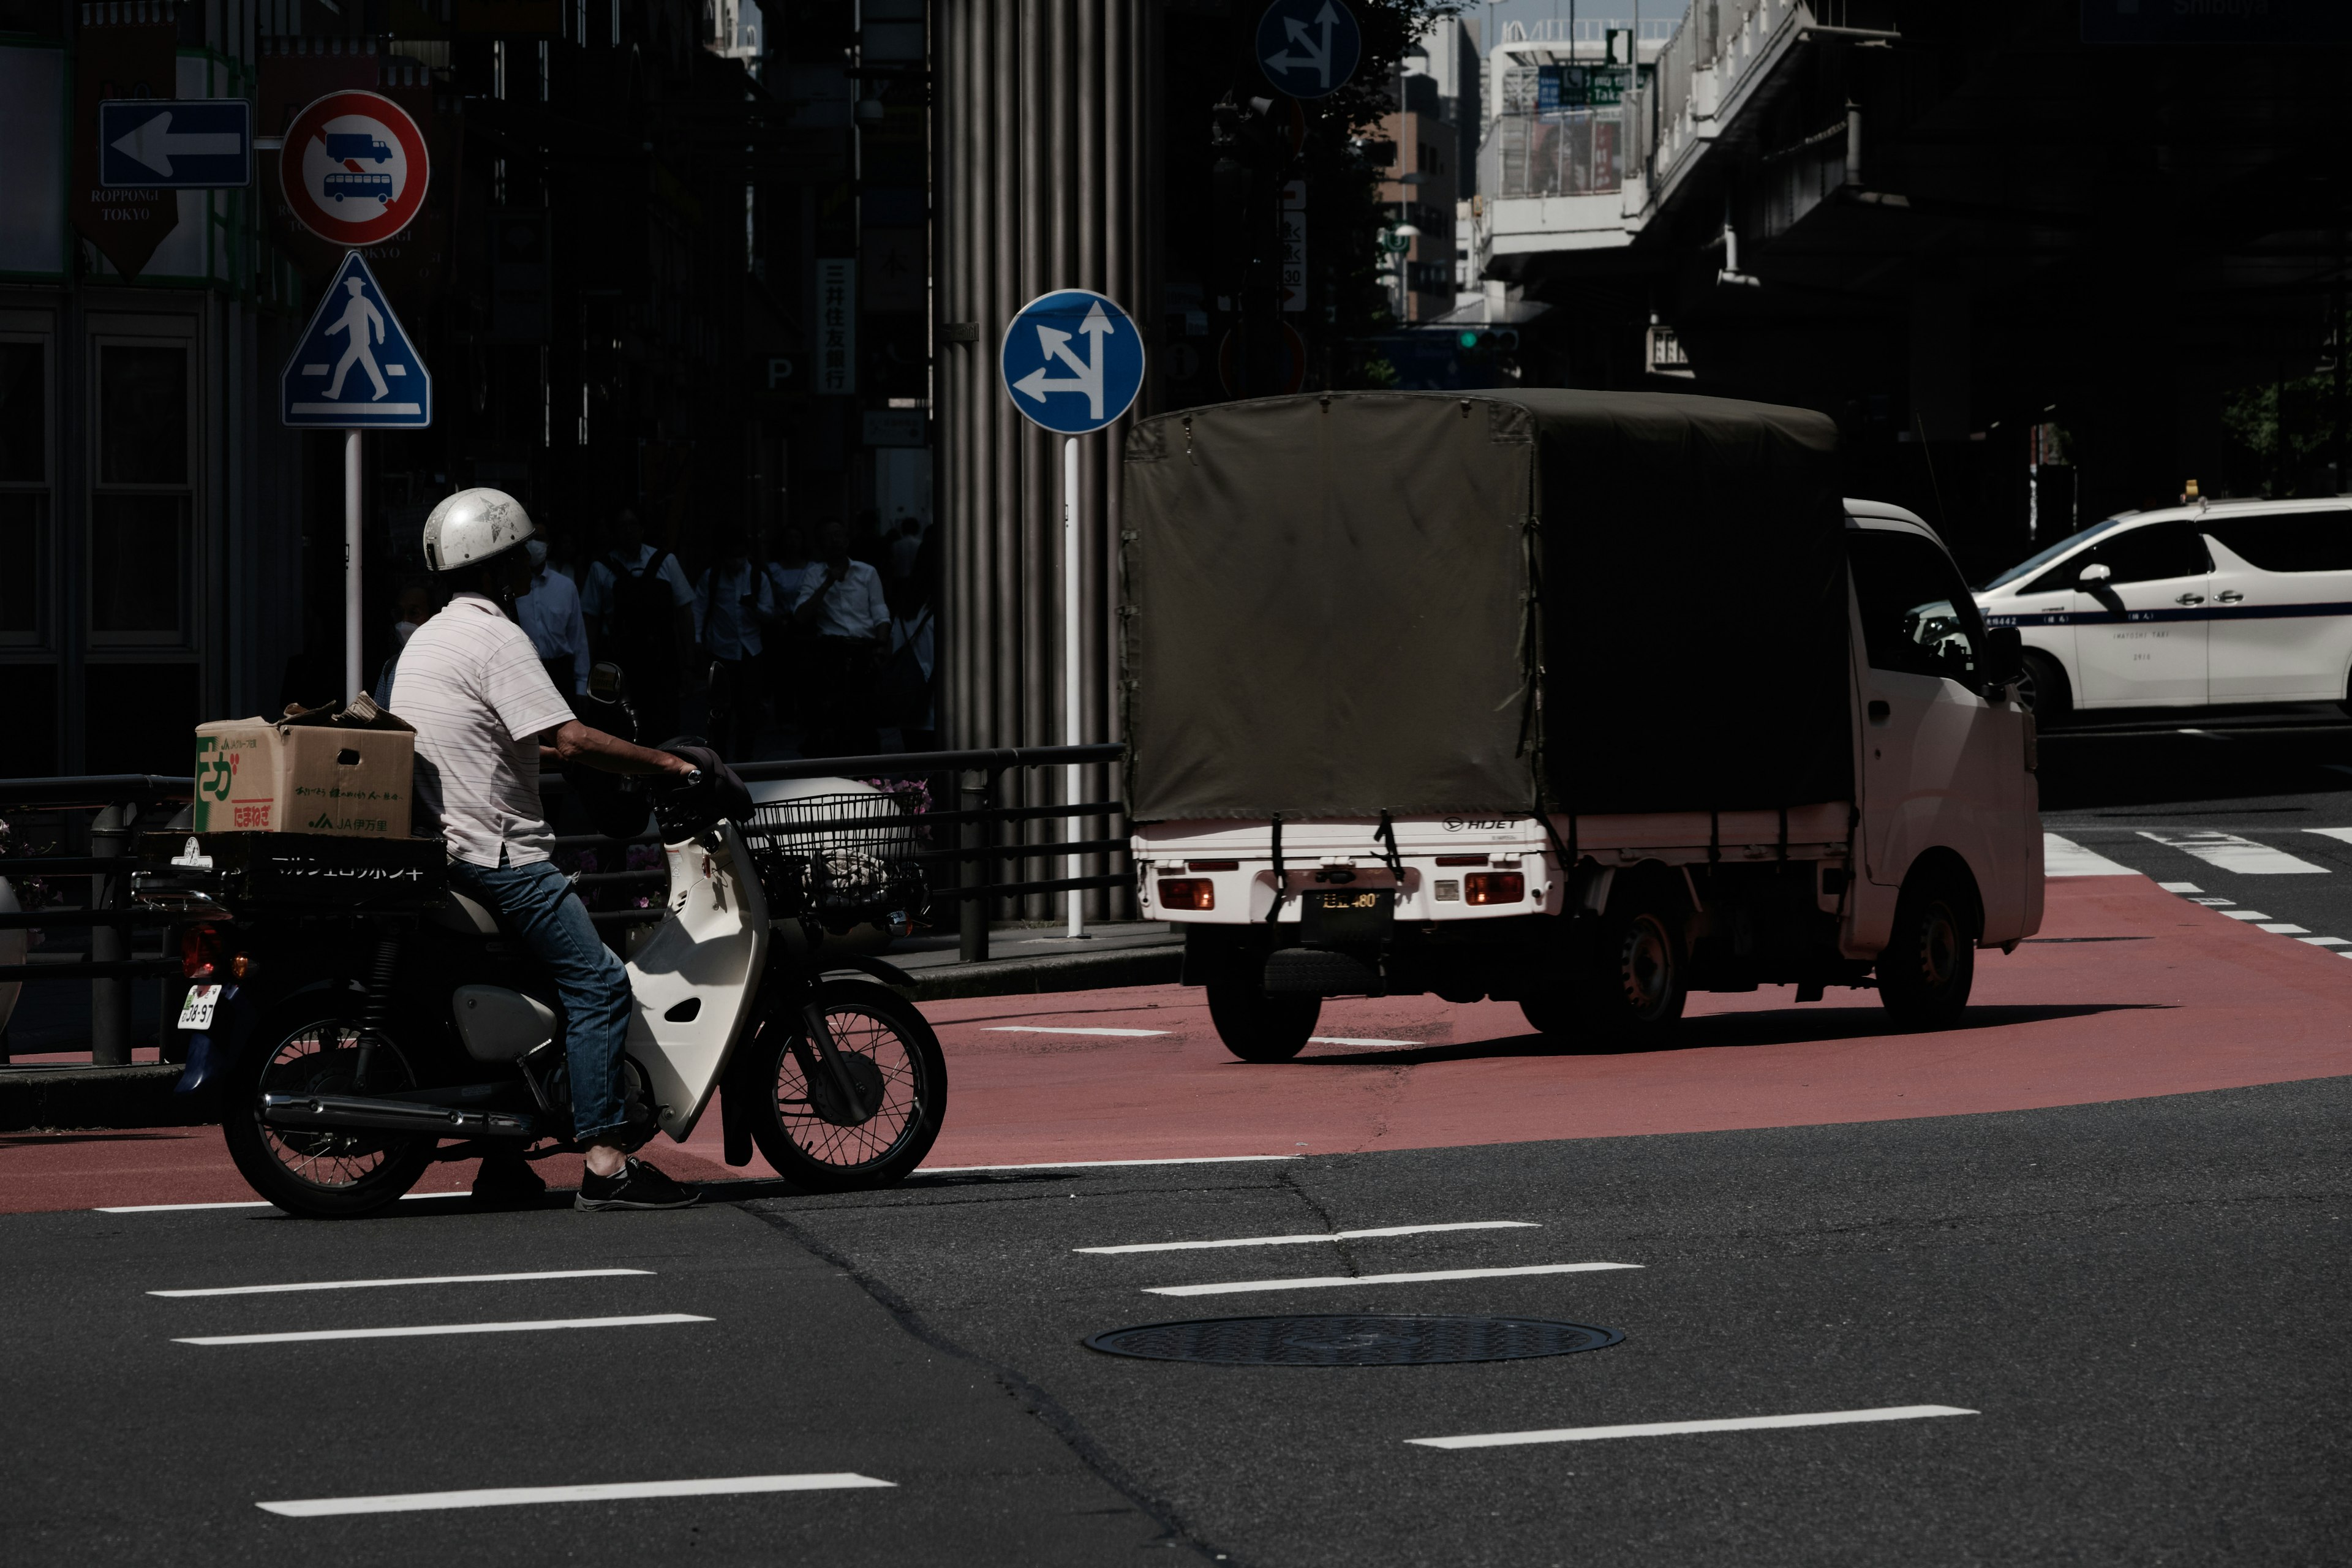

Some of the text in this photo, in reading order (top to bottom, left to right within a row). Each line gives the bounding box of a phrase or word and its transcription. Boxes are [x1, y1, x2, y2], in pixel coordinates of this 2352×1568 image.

[2174, 0, 2269, 19] Shibuya
[91, 189, 159, 203] ROPPONGI
[101, 208, 150, 221] TOKYO
[361, 247, 401, 259] OKYO
[825, 265, 845, 390] 三井住友銀行
[767, 358, 793, 389] P
[234, 805, 271, 827] たまねぎ
[337, 818, 387, 831] JA伊万里
[1468, 820, 1519, 829] HIJET
